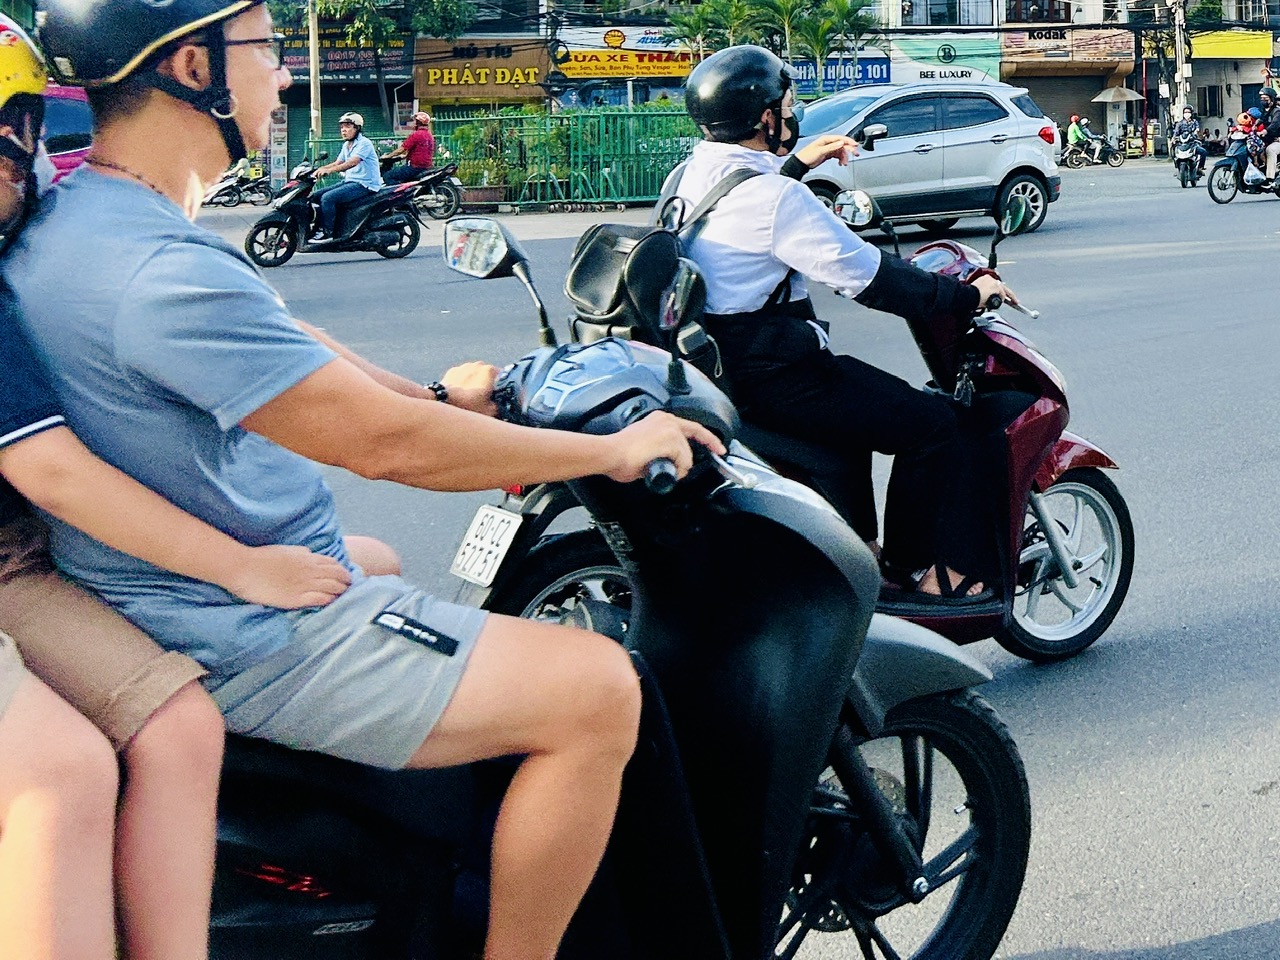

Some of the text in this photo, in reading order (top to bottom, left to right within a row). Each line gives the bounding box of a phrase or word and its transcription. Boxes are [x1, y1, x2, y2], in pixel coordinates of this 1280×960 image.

[1028, 29, 1067, 40] Kodak
[606, 54, 629, 62] XE
[427, 63, 490, 85] PHÁT
[495, 67, 540, 89] ĐẠT
[866, 64, 888, 79] 101
[920, 70, 973, 79] BEE LUXURY
[475, 513, 511, 548] 60-C2
